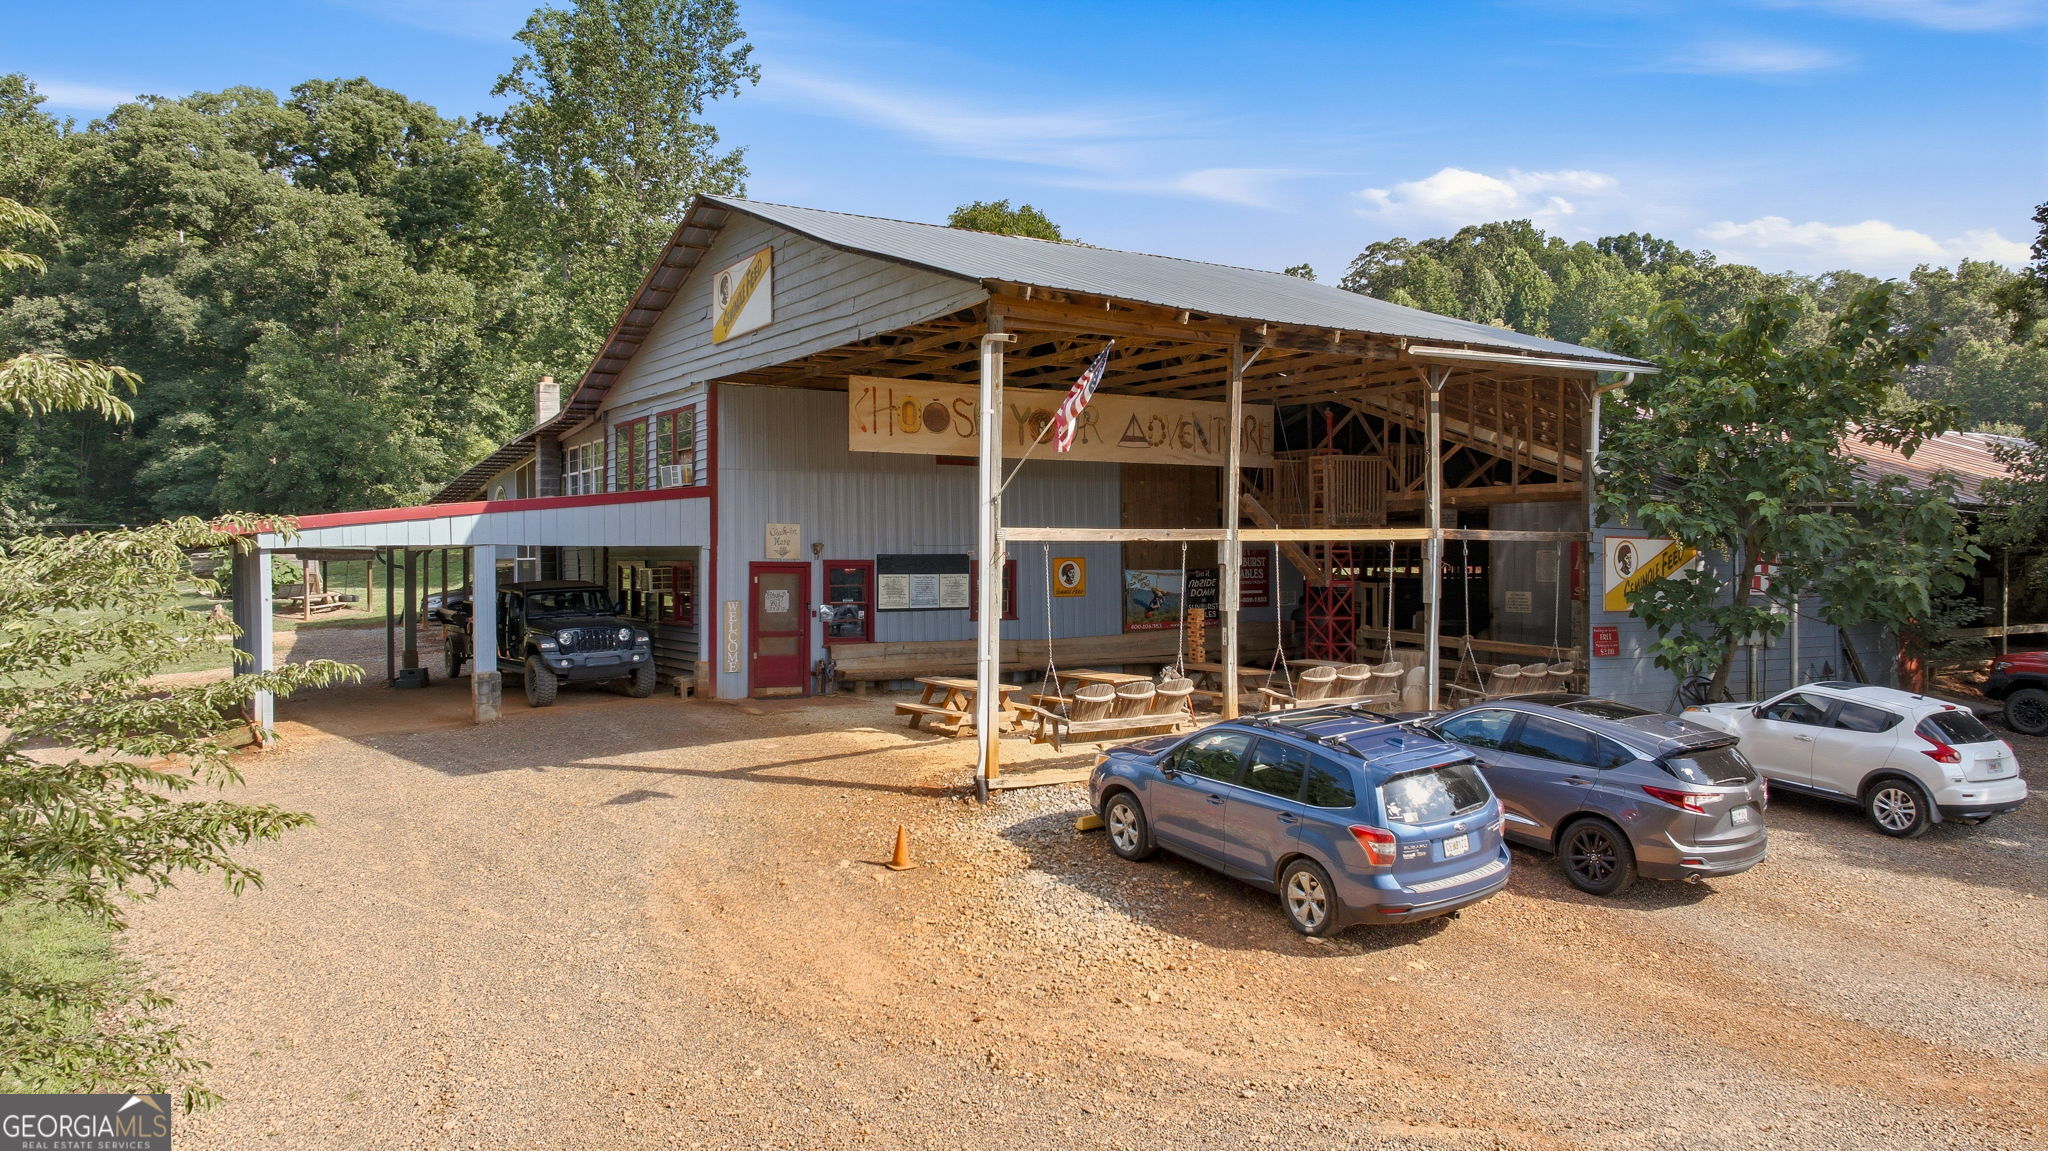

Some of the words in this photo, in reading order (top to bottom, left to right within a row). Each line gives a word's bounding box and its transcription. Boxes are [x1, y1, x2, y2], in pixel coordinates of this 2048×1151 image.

[853, 386, 980, 438] CHOOS
[1010, 403, 1104, 446] YOR
[1116, 412, 1272, 455] ADVENTRE
[1240, 569, 1264, 579] ABLES
[1242, 557, 1267, 567] BURST
[727, 601, 739, 673] WELCOME
